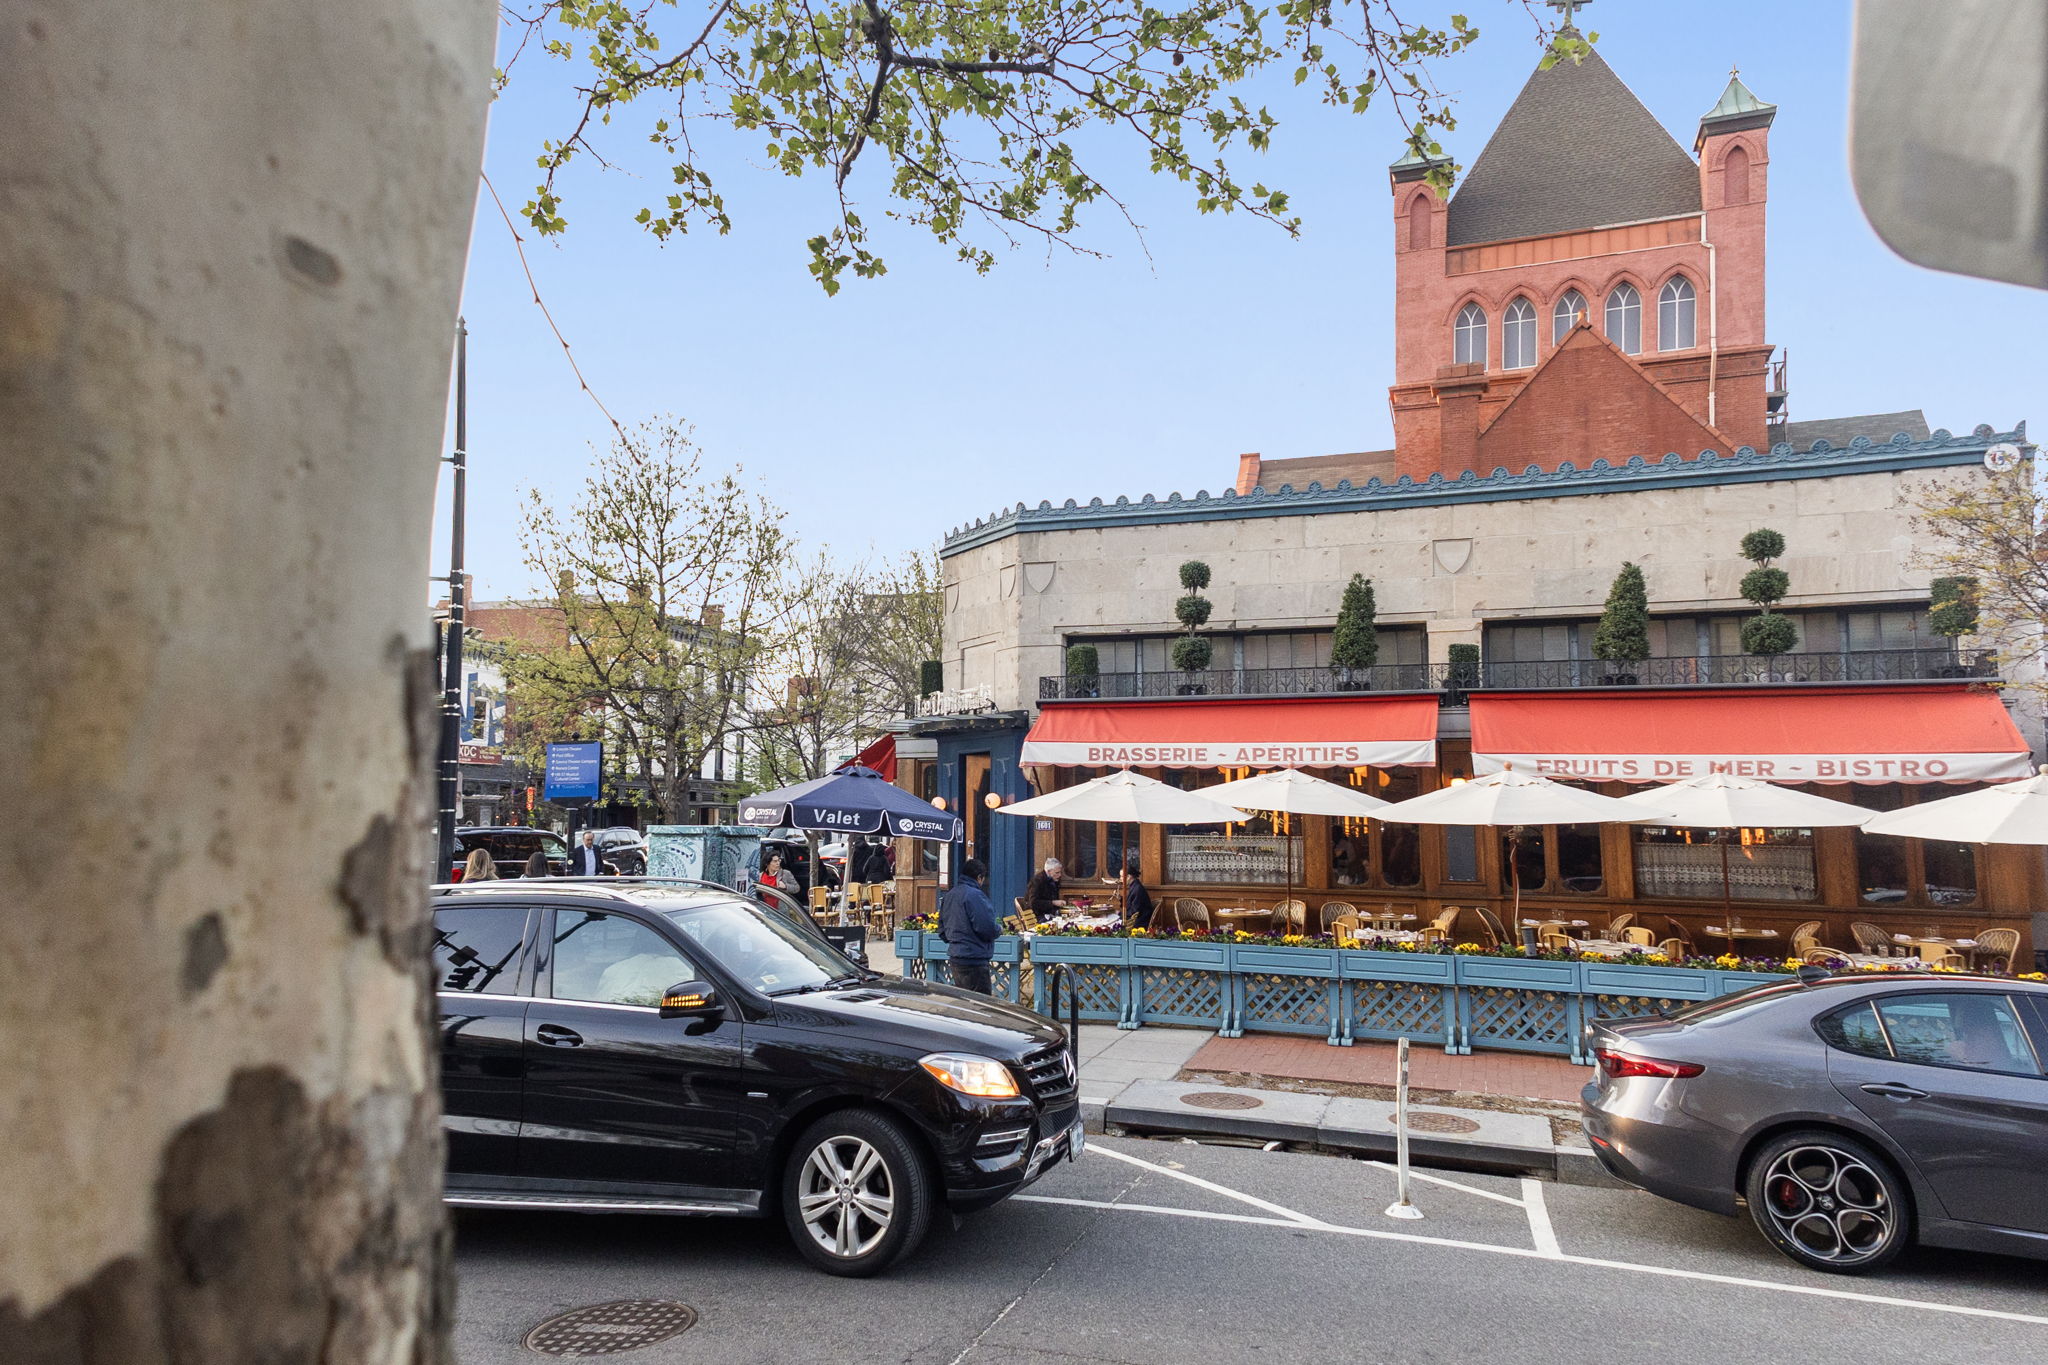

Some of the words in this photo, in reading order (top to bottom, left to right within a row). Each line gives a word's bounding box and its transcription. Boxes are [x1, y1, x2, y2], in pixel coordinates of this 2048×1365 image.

[1088, 747, 1208, 762] BRASSERIE
[1536, 759, 1639, 776] FRUITS
[1654, 760, 1694, 777] DE
[1709, 760, 1776, 777] MER
[1816, 759, 1949, 777] BISTRO
[756, 808, 777, 816] CRYSTAL
[813, 808, 860, 826] Valet
[914, 821, 944, 831] CRYSTAL
